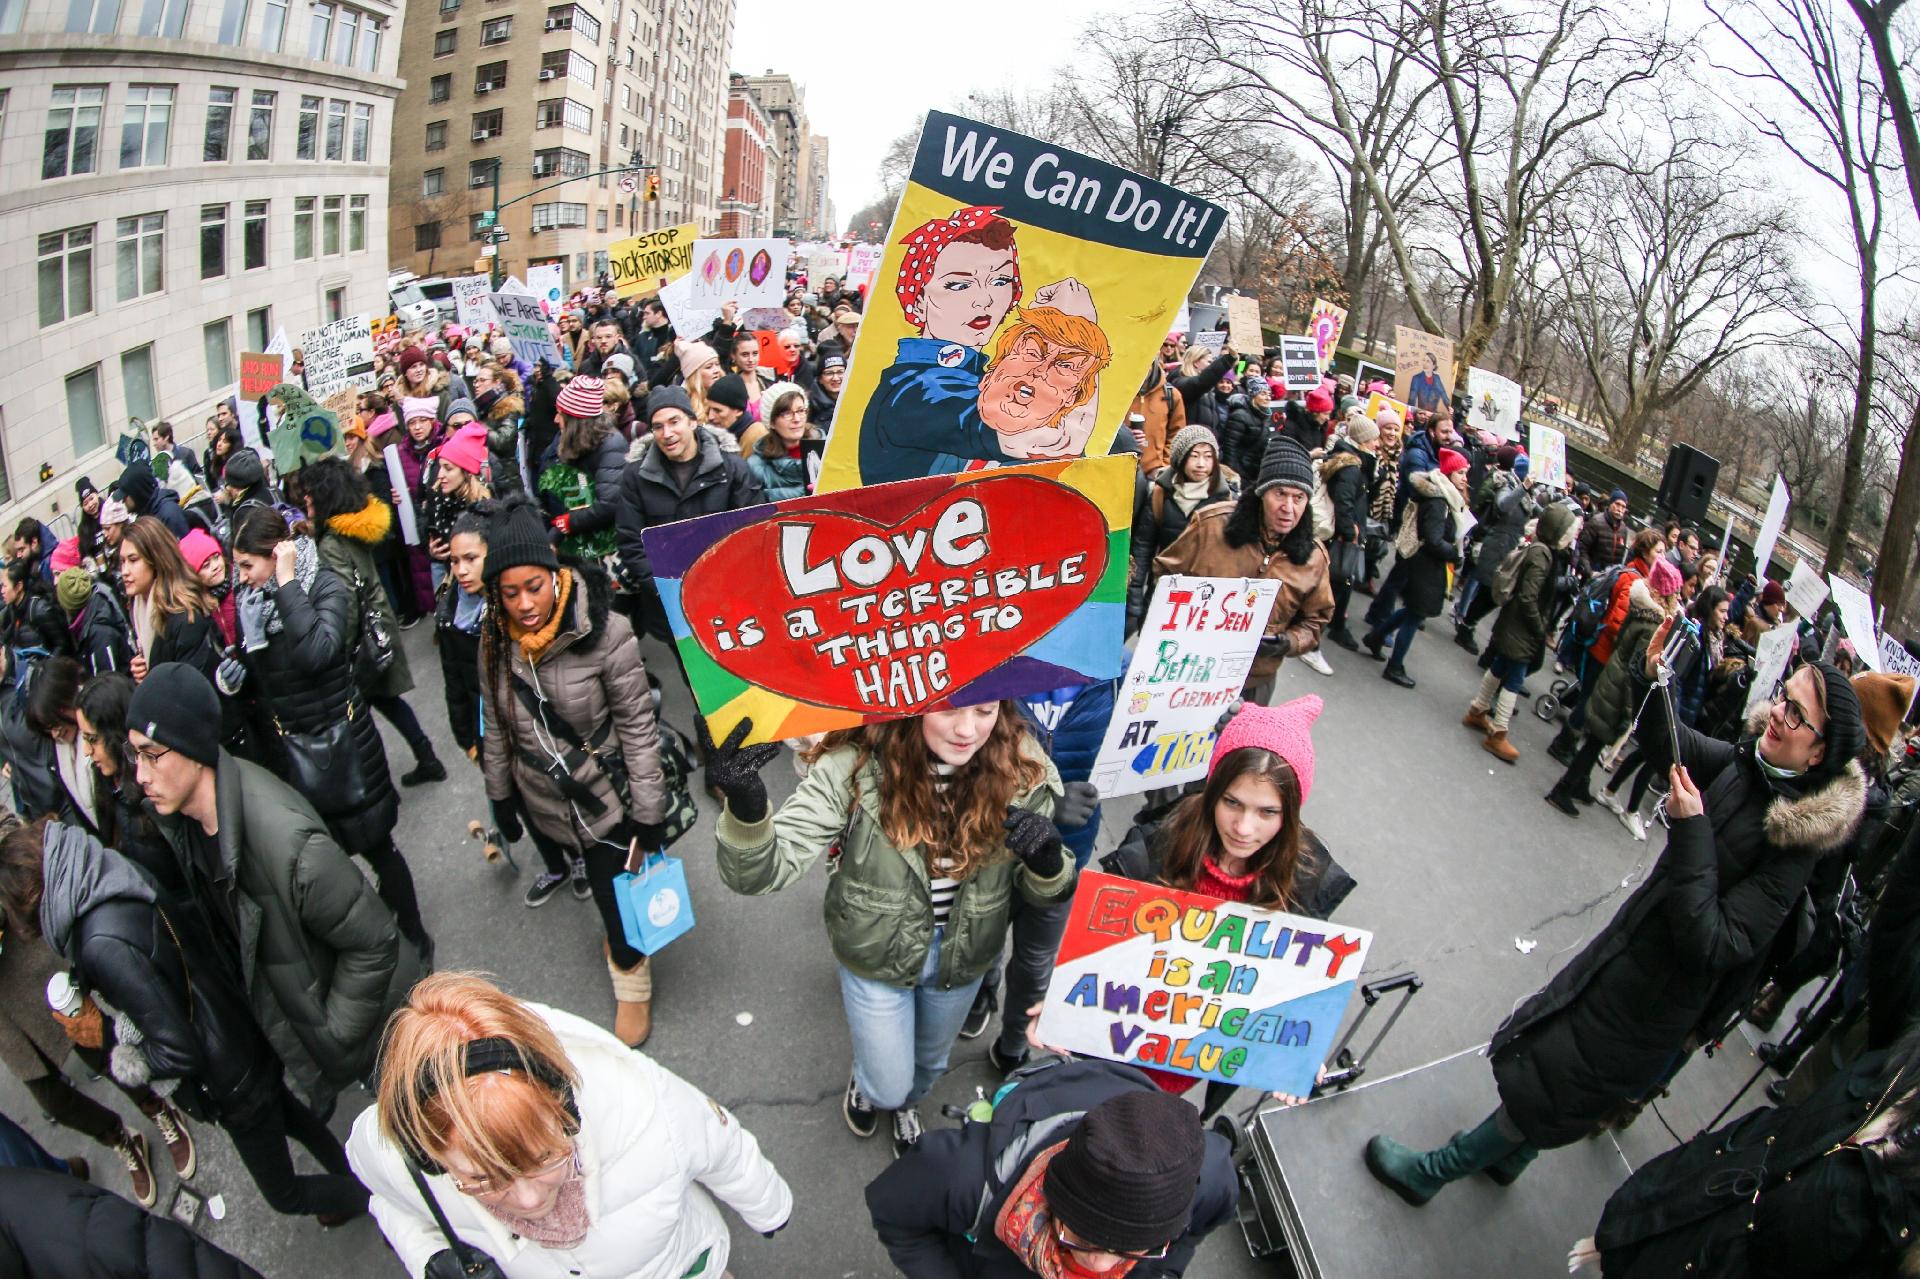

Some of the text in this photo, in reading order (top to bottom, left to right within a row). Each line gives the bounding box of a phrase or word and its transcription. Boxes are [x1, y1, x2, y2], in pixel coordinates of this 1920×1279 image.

[942, 126, 1213, 249] We Can Do It!
[638, 229, 678, 248] STOP
[464, 295, 486, 307] NOT
[489, 297, 545, 322] WE ARE
[318, 323, 334, 338] NOT
[335, 316, 359, 333] FREE
[335, 328, 370, 344] WOMAN
[262, 361, 279, 377] RUN
[344, 352, 363, 366] HER
[778, 498, 990, 598] Love
[712, 613, 765, 652] is
[785, 605, 822, 641] a
[972, 604, 1024, 635] TO
[1885, 640, 1908, 662] KNOW
[1118, 720, 1159, 750] AT
[1088, 887, 1361, 978] EQUALITY
[1147, 950, 1258, 995] is an
